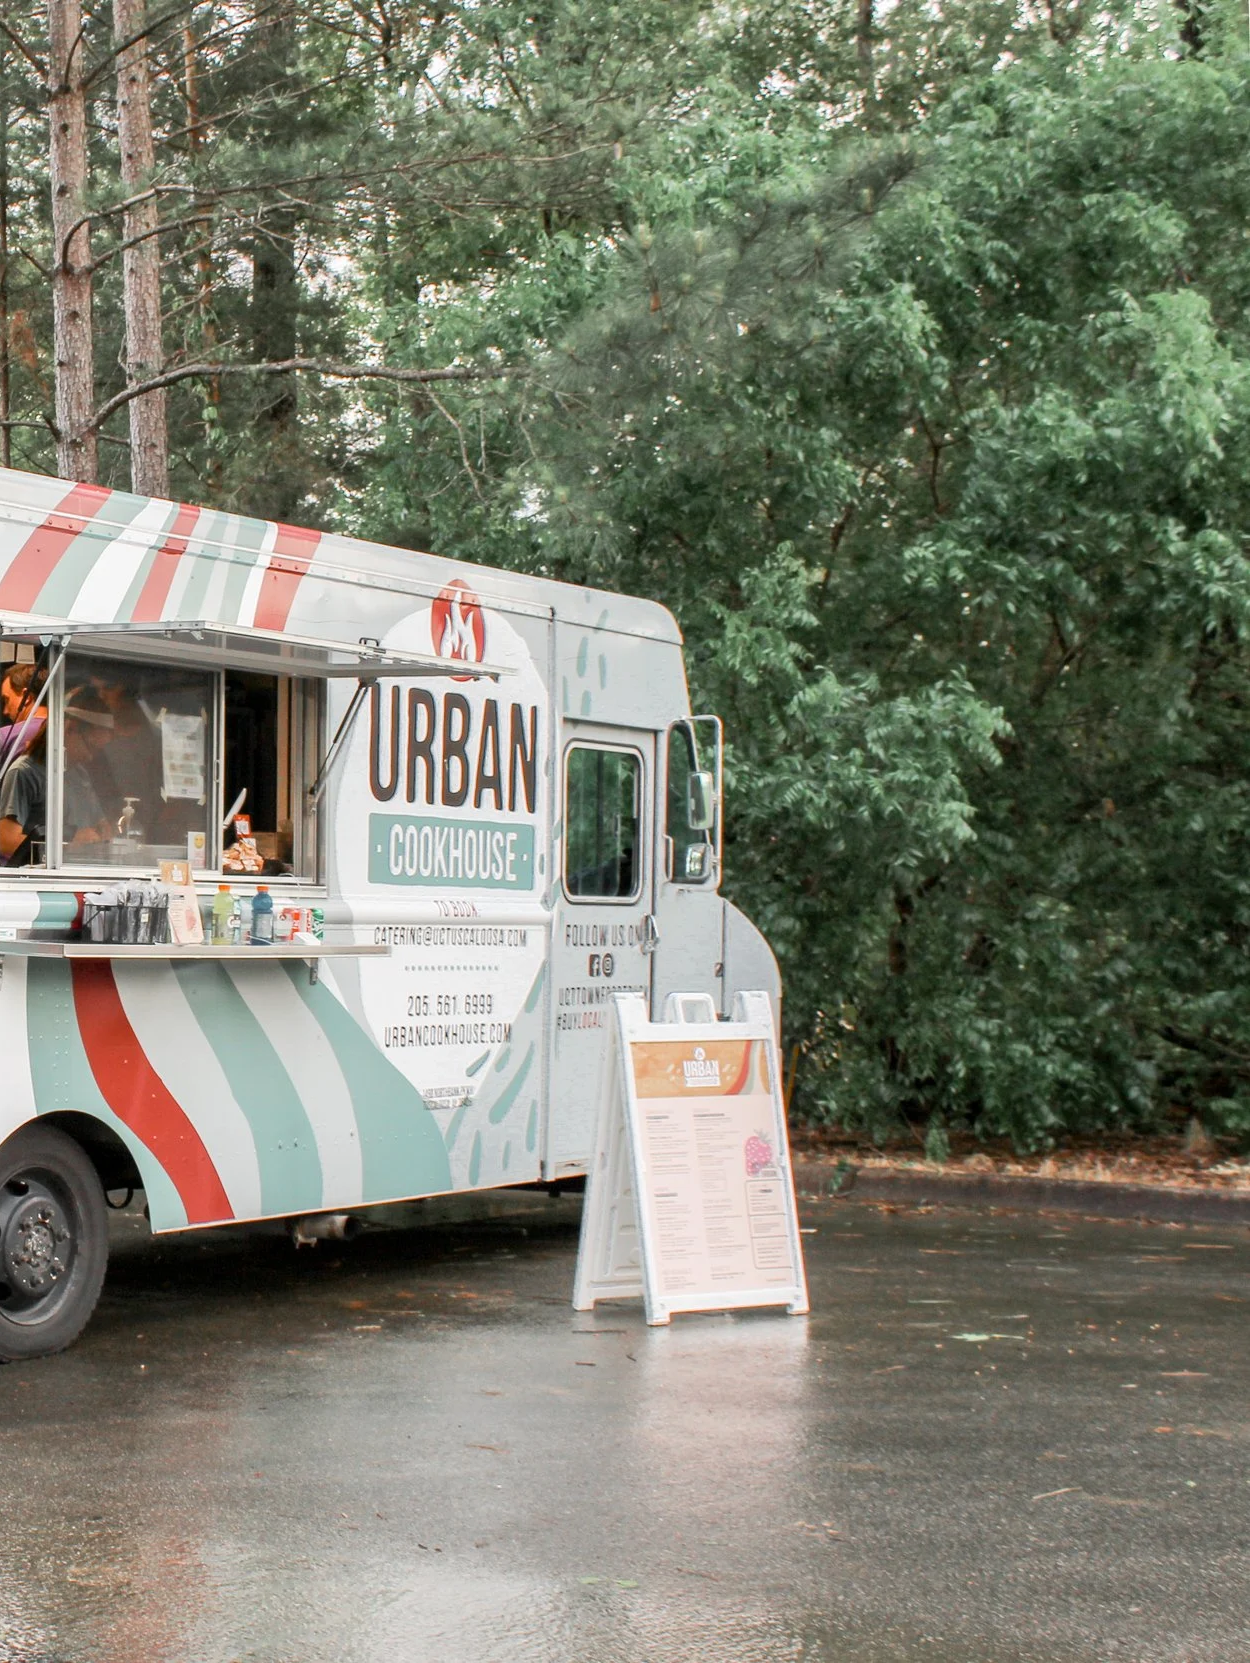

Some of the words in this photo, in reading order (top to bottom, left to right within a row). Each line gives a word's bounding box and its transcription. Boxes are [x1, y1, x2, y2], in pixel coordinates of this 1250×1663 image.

[369, 681, 538, 814] URBAN
[388, 822, 519, 881] COOKHOUSE
[433, 900, 449, 917] TO
[374, 926, 527, 947] CATERING@UCTUSCALOOSA.COM
[565, 924, 608, 947] FOLLOW
[611, 924, 624, 947] US
[407, 995, 432, 1017] 205.
[436, 994, 461, 1016] 561.
[464, 993, 493, 1015] 6999
[384, 1023, 512, 1048] URBANCOOKHOUSE.COM
[682, 1060, 720, 1077] URBAN
